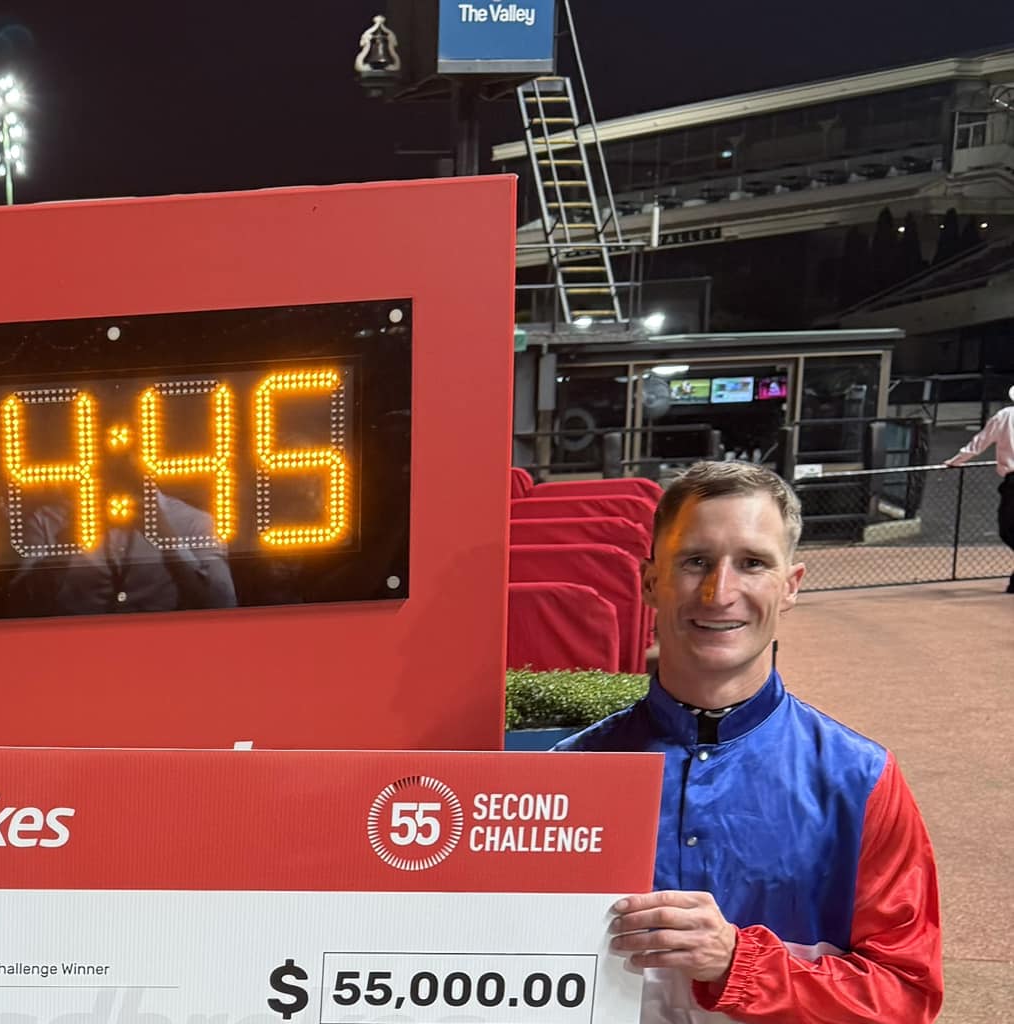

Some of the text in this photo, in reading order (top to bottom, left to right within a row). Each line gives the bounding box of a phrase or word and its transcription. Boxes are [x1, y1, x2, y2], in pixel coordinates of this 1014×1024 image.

[458, 4, 536, 26] The Valley
[472, 793, 569, 821] SECOND
[389, 802, 441, 846] 55
[469, 826, 604, 853] CHALLENGE
[61, 963, 110, 976] Winner
[267, 959, 309, 1020] $
[332, 971, 586, 1009] 55,000.00
